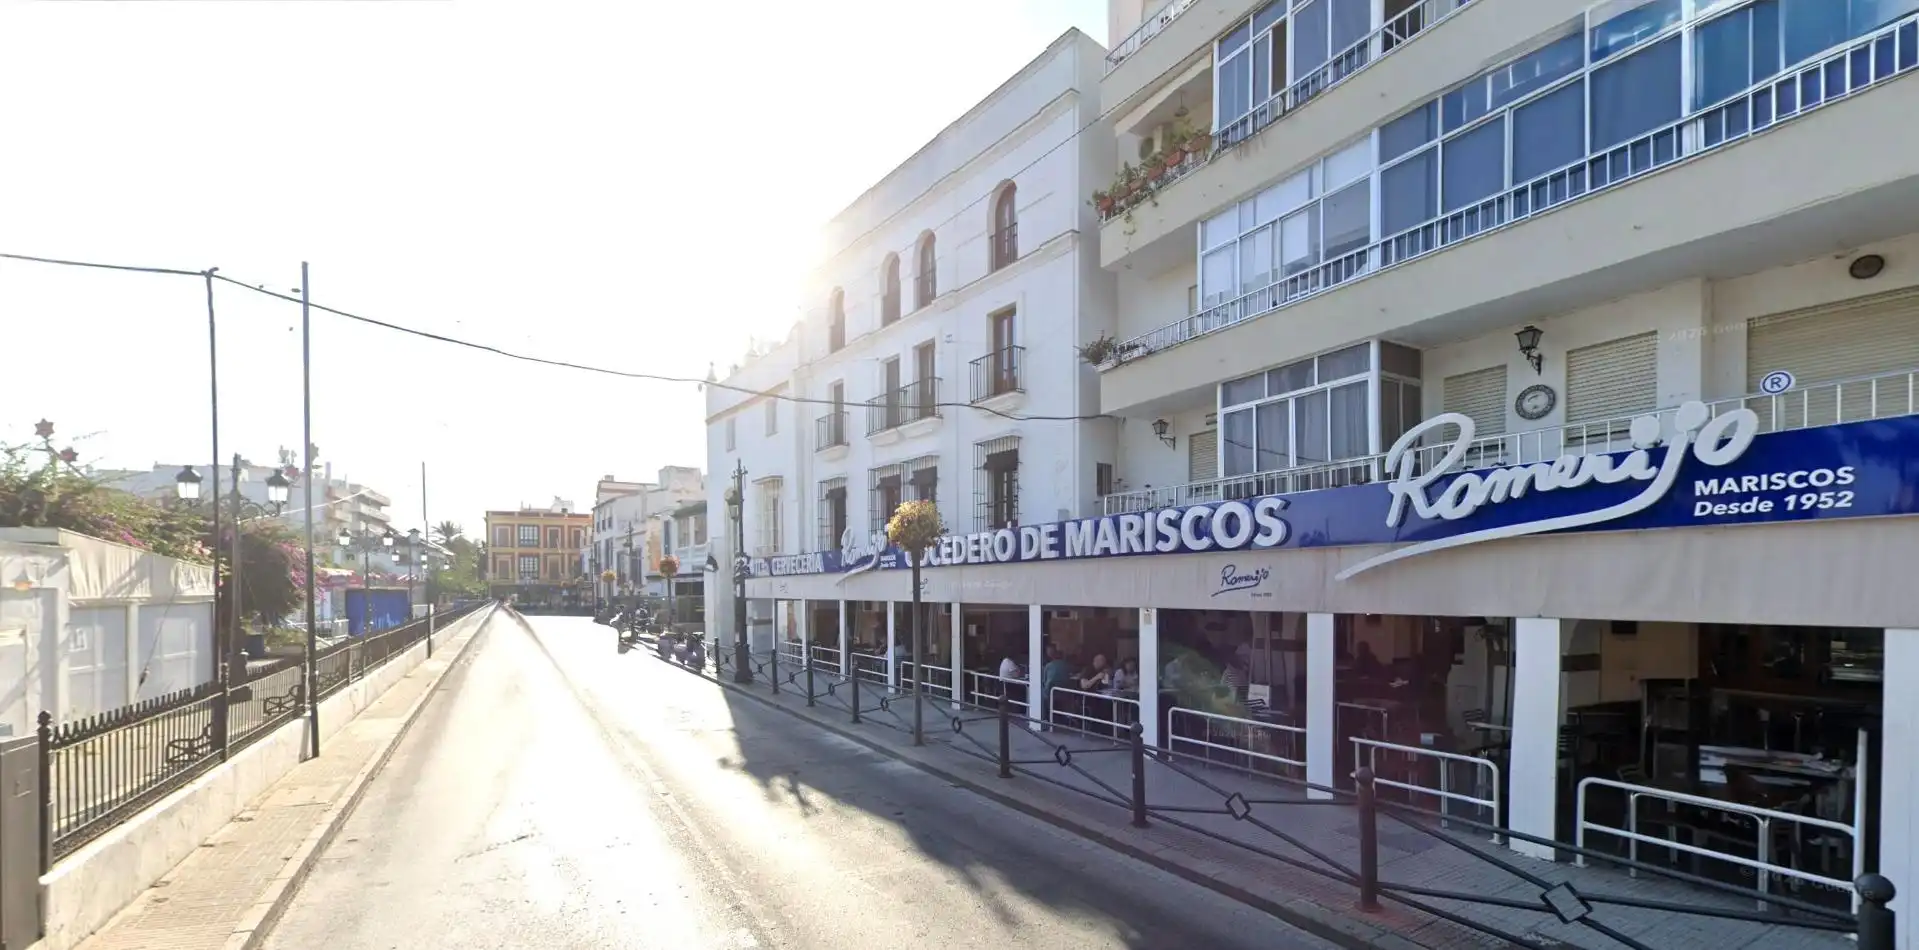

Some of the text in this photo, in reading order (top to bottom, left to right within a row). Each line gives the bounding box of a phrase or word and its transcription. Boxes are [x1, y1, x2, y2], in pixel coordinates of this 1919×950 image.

[1334, 401, 1758, 580] Romerijo
[1694, 466, 1855, 497] MARISCOS
[1694, 490, 1855, 516] Desde 1952
[1020, 524, 1060, 560] DE
[1065, 498, 1288, 557] MARISCOS
[1211, 563, 1271, 597] Romerijo
